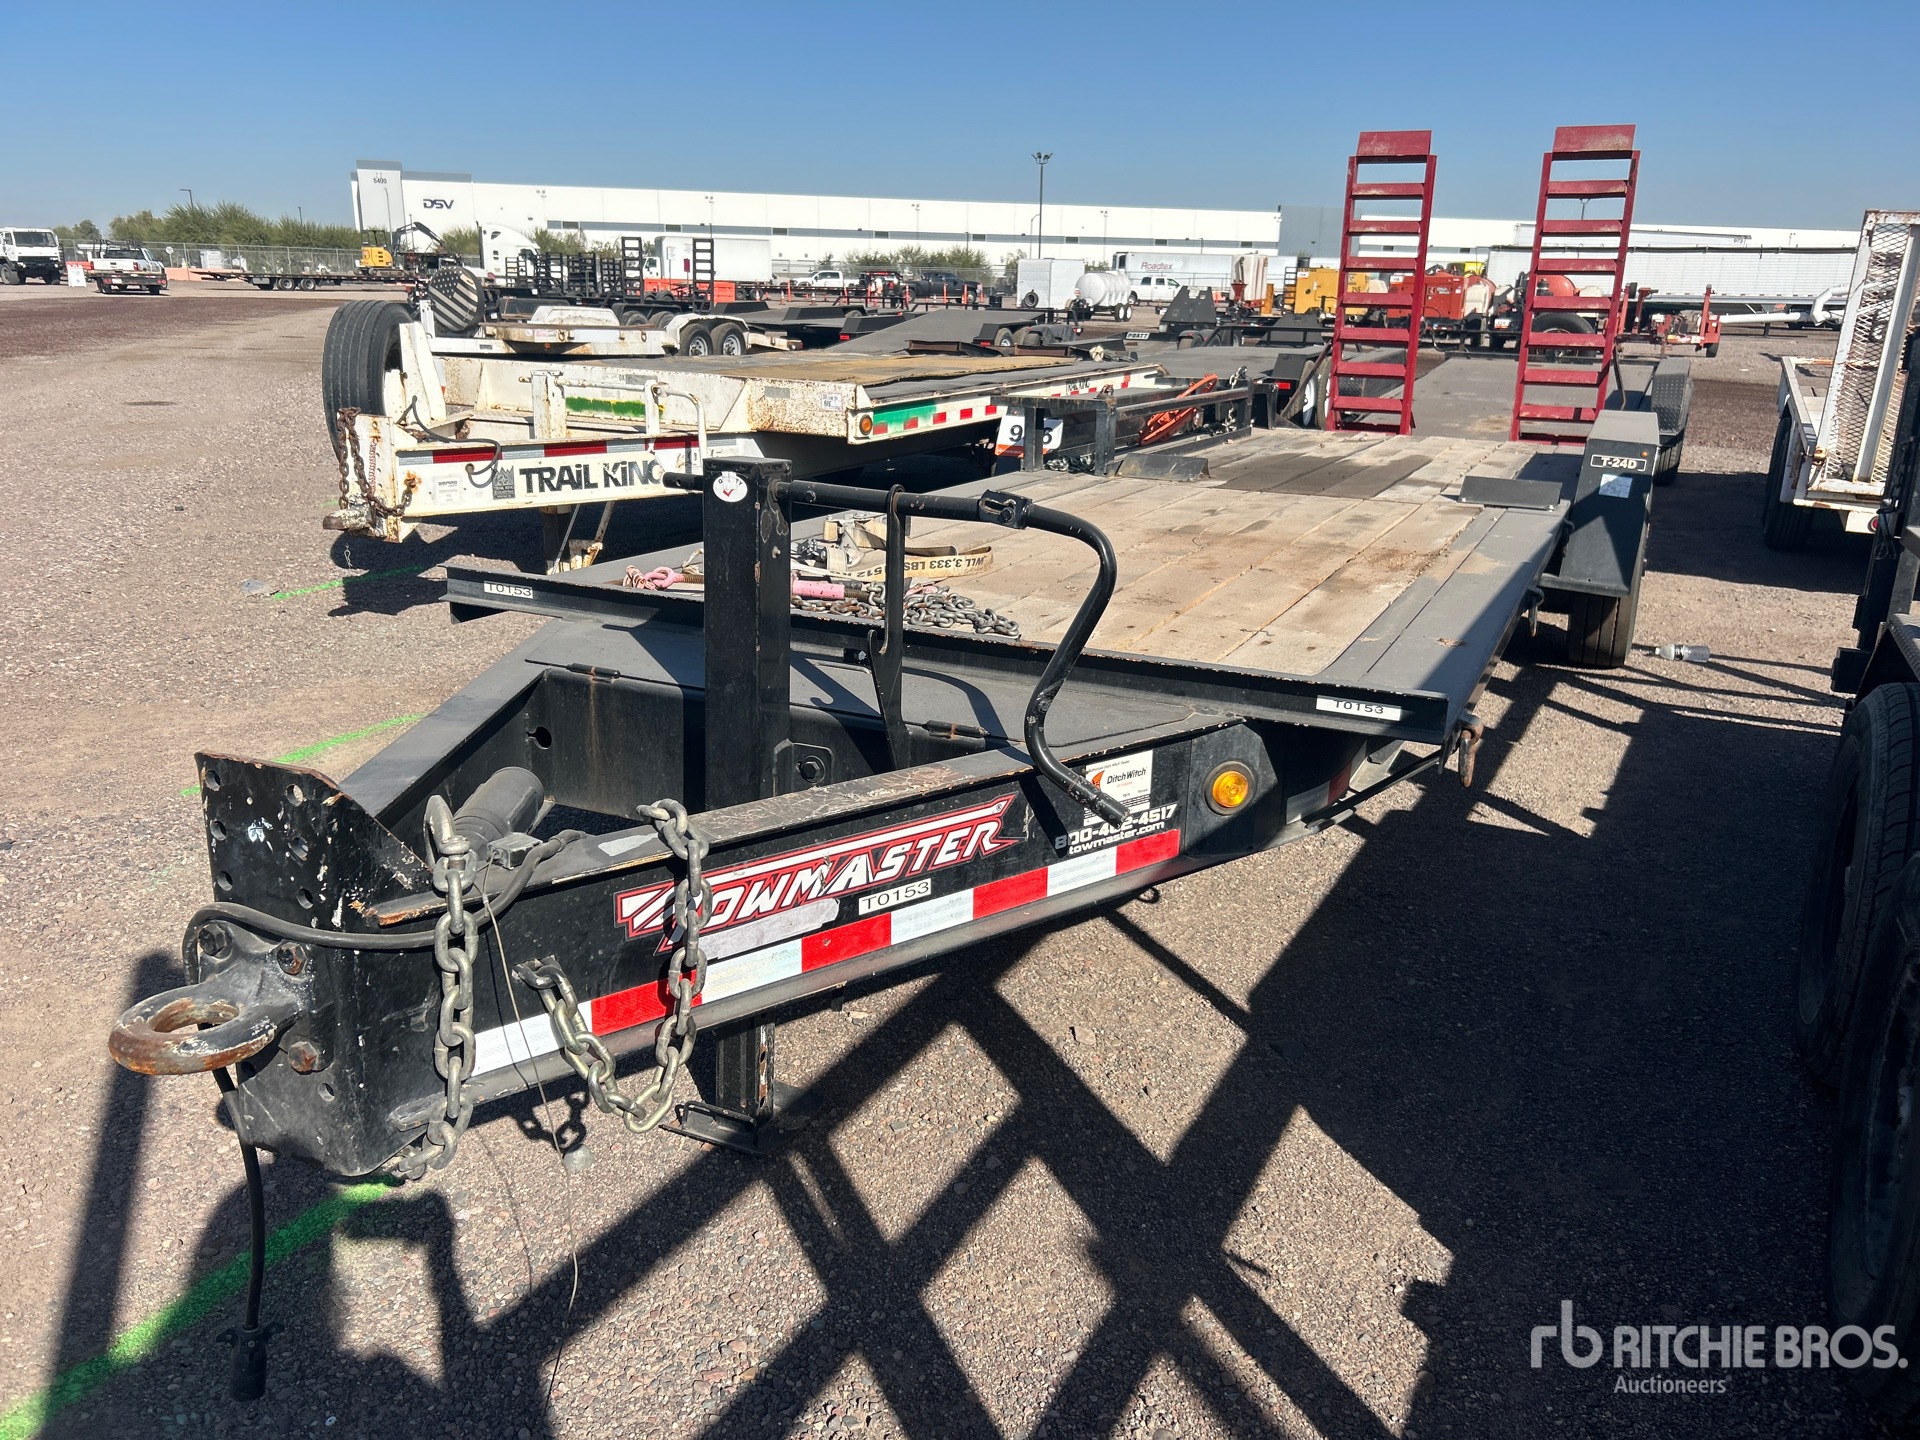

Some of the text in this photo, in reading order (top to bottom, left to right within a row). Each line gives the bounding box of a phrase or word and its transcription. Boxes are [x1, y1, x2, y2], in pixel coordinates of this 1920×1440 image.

[423, 199, 455, 210] DSV
[1009, 425, 1053, 444] 96
[1601, 456, 1637, 469] T-24D
[904, 560, 926, 571] LBS
[929, 558, 963, 569] 3,333
[965, 556, 986, 567] WLL
[485, 582, 532, 597] T0153
[1333, 699, 1384, 714] T0153
[1107, 767, 1146, 784] Ditch Witch
[1068, 821, 1165, 855] towmaster.com
[862, 881, 929, 909] T0153
